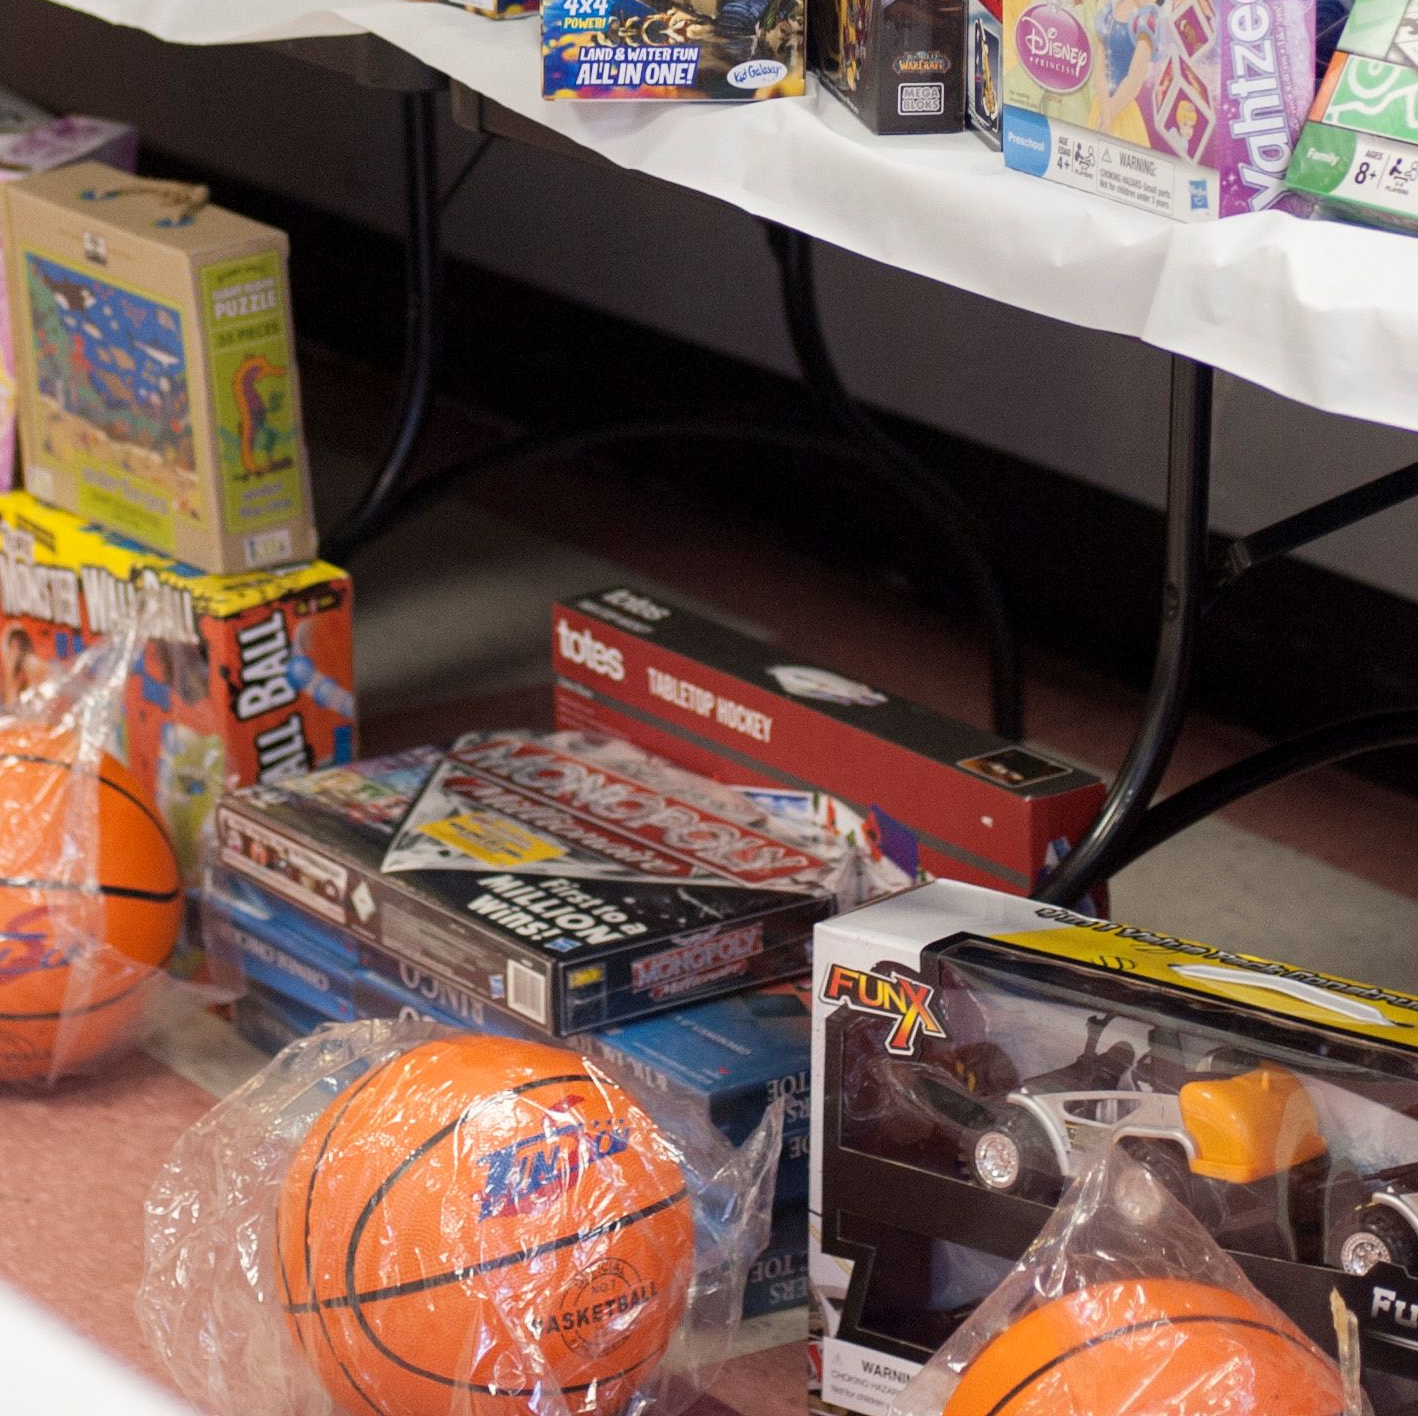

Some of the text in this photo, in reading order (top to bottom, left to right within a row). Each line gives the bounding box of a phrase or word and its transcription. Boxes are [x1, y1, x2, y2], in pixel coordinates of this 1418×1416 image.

[580, 47, 698, 61] LAND & WATER FUN
[899, 59, 944, 72] WARCRAFT
[577, 63, 696, 85] ALL IN ONE!
[1033, 58, 1076, 75] PRINCESS
[903, 88, 939, 99] MEGA
[903, 100, 939, 111] BLOKS
[1007, 133, 1045, 151] Preschool
[1119, 151, 1156, 176] WARNING:
[1365, 150, 1383, 160] AGES
[1354, 162, 1376, 185] 8+
[213, 290, 279, 320] PUZZLE
[558, 620, 625, 681] totes
[648, 666, 772, 743] TABLETOP HOCKEY
[480, 874, 628, 946] MILLION
[539, 877, 648, 935] First to a
[468, 898, 554, 942] Wins!
[633, 928, 760, 988] MONOPOLY
